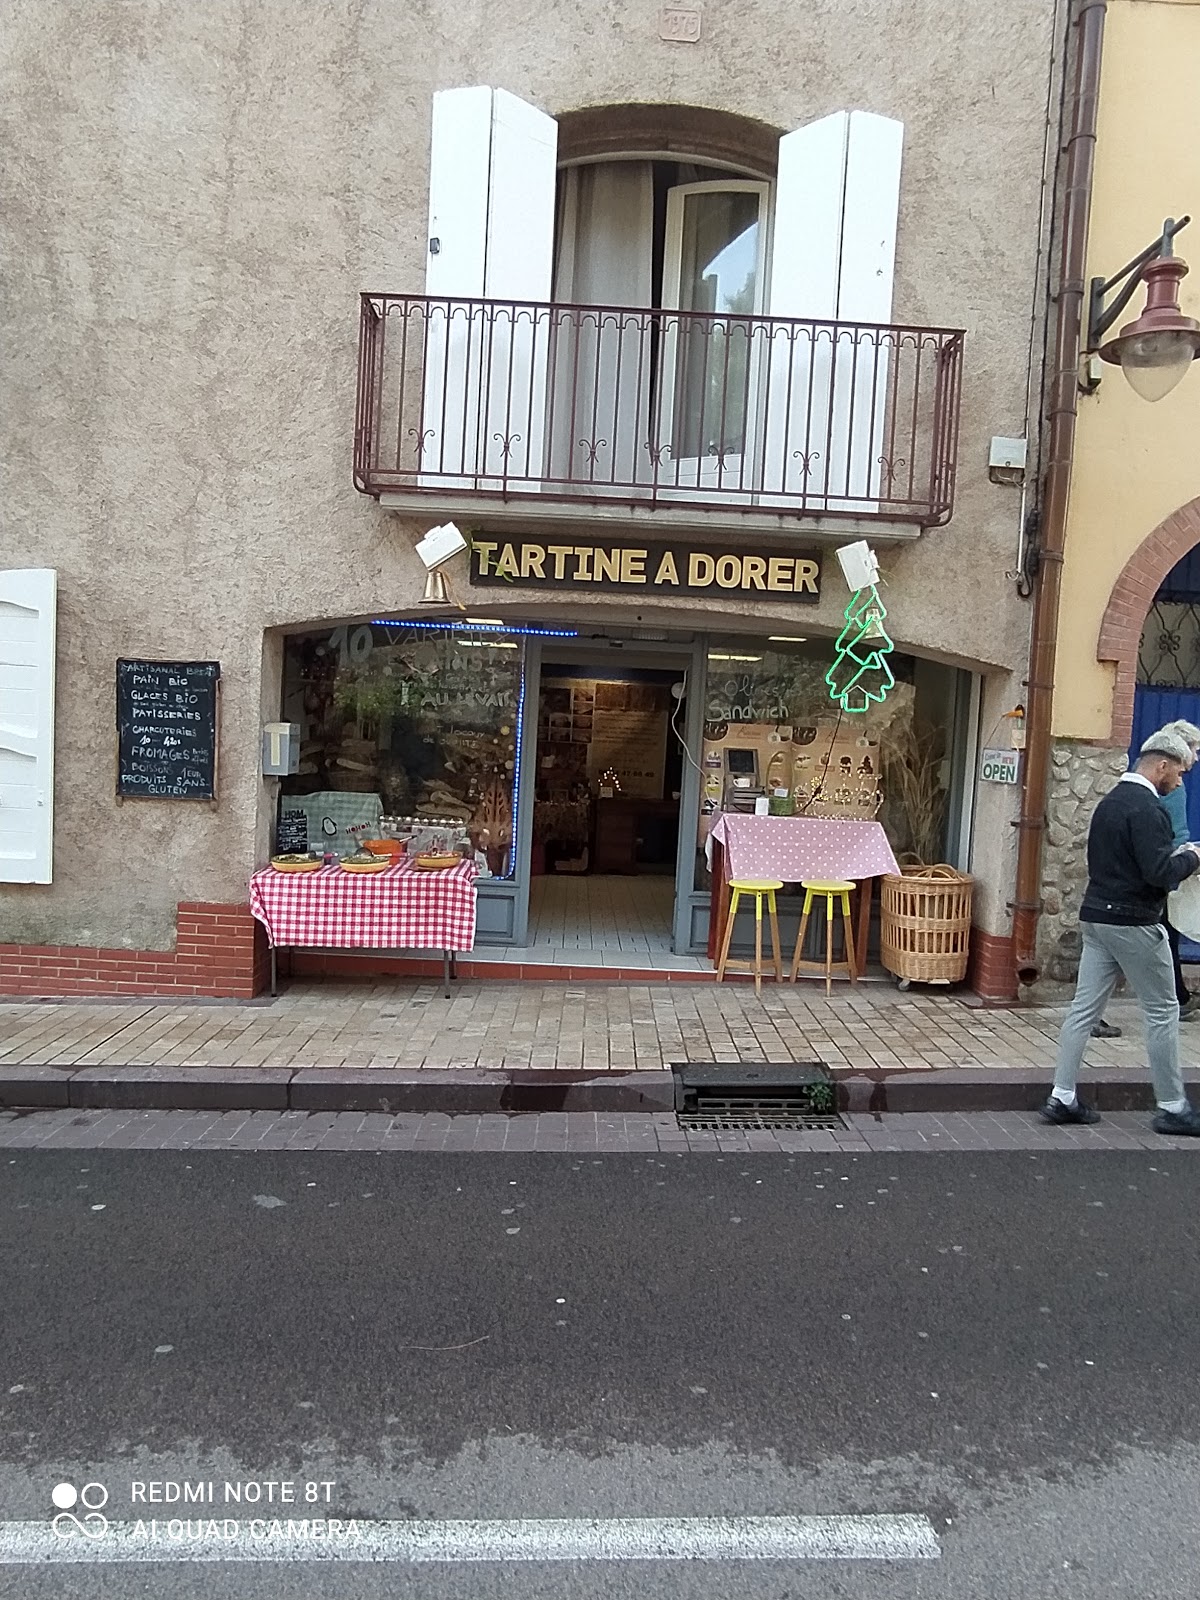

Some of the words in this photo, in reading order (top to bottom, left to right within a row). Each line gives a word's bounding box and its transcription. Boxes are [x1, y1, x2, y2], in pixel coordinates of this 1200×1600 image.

[472, 541, 647, 584] TARTINE
[654, 551, 680, 586] A
[688, 553, 818, 594] DORER
[328, 624, 374, 667] 10
[131, 690, 168, 701] GLACES
[706, 698, 789, 722] Sandwich
[131, 745, 190, 761] FROMAGES
[121, 774, 167, 785] PRODUITS
[983, 764, 1015, 781] OPEN
[148, 784, 189, 795] GLUTEN
